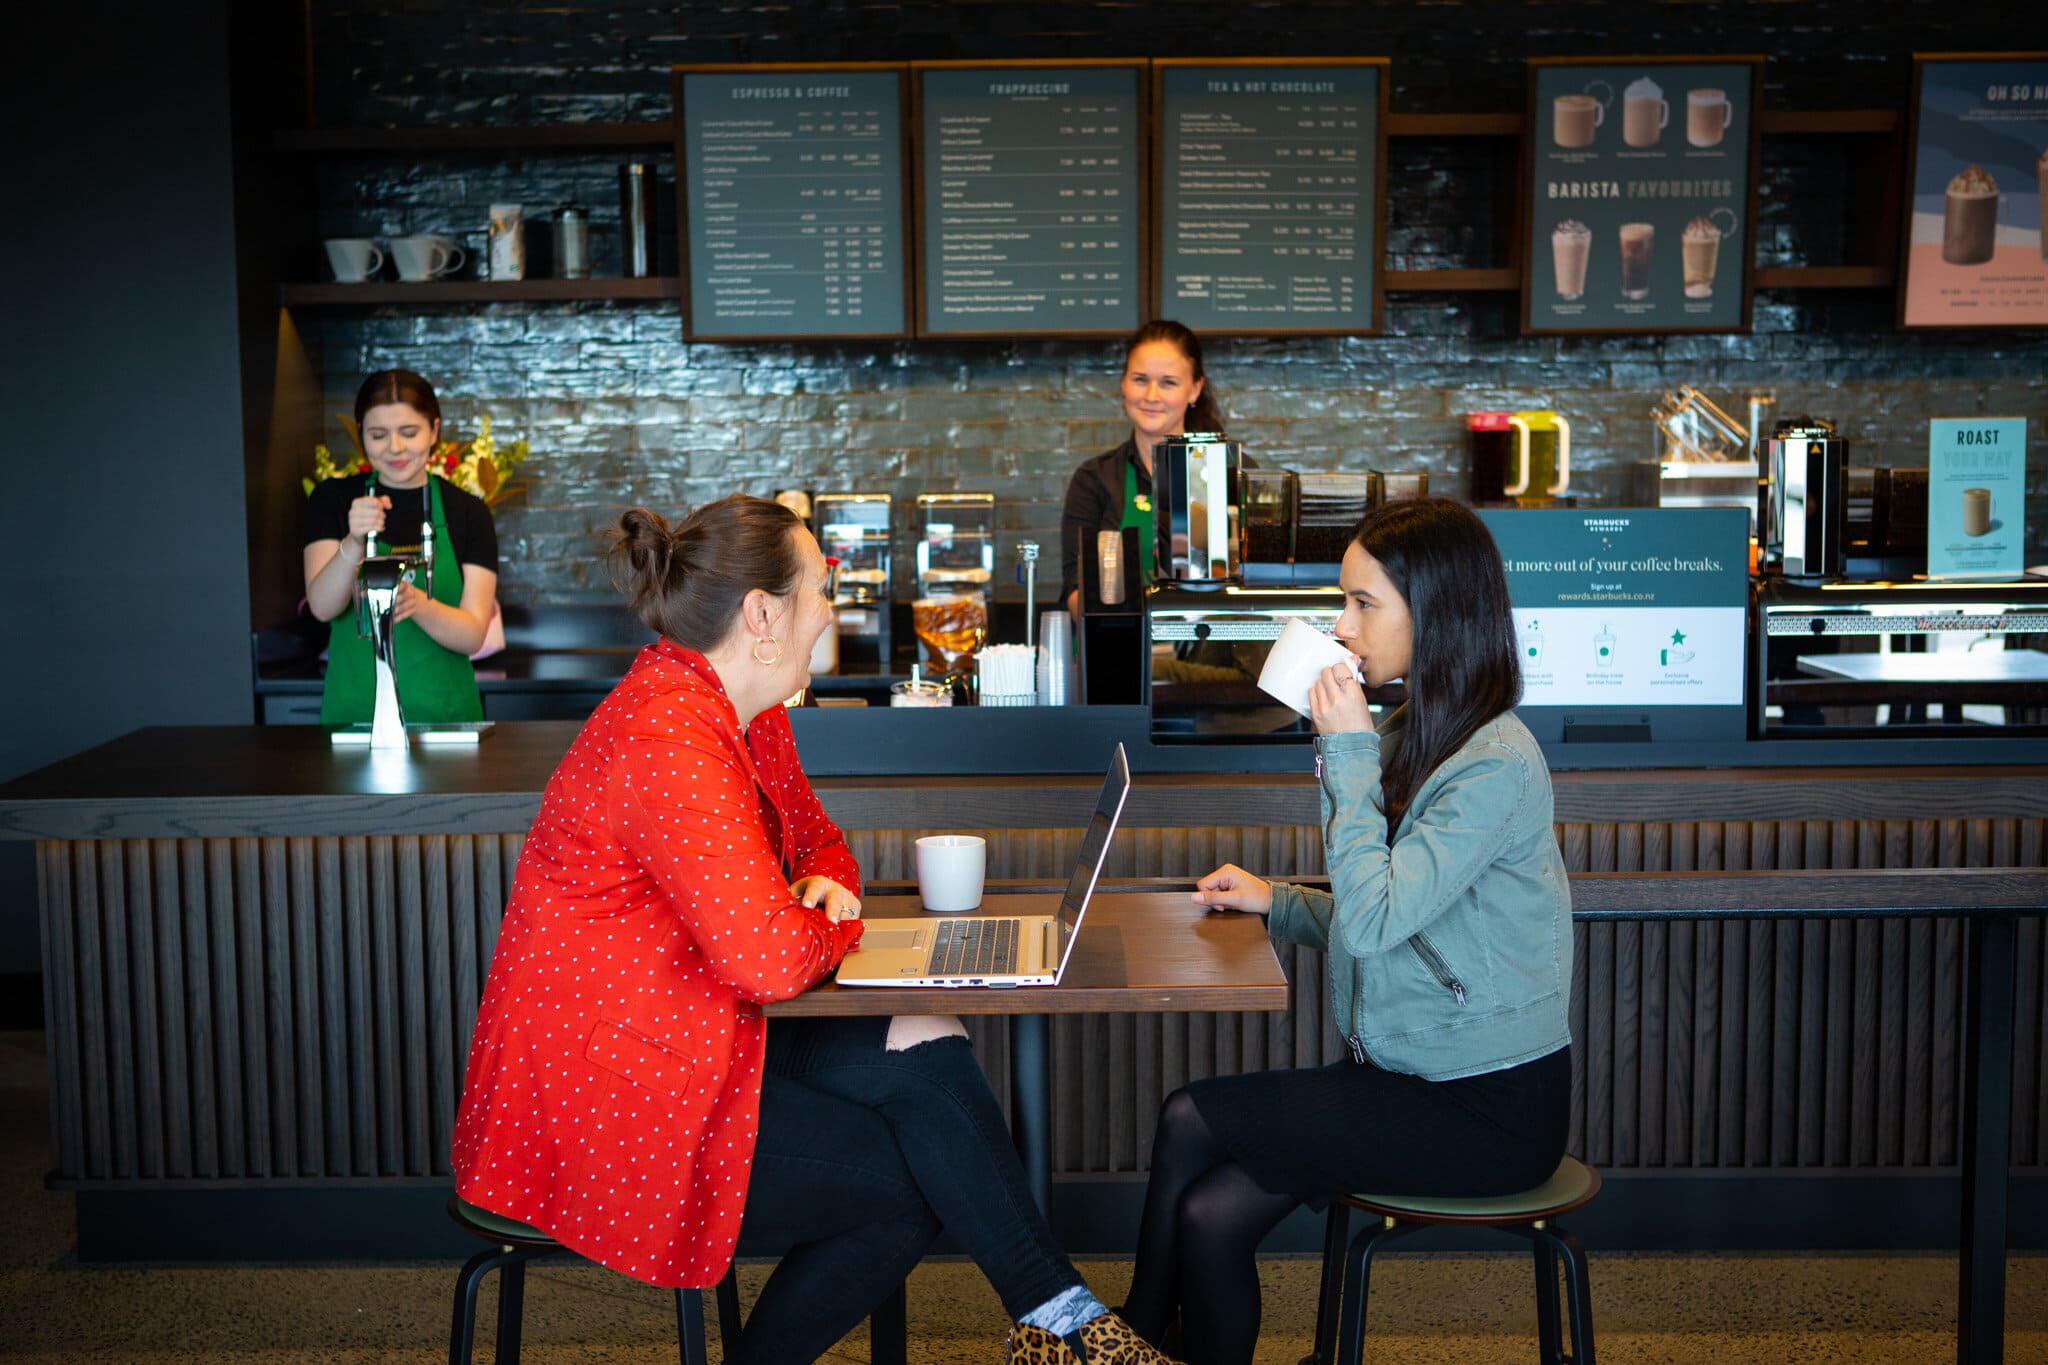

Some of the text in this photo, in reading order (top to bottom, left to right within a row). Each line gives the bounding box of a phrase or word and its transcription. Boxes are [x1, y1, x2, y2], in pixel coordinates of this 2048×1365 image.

[732, 87, 850, 99] ESPRESSO & COFFEE
[989, 84, 1070, 95] FRAPPUCCINO
[1208, 82, 1336, 93] TEA & HOT CHOCOLATE
[1988, 86, 2008, 100] OH
[2011, 86, 2030, 100] SO
[1547, 180, 1732, 199] BARISTA FAVOURITES
[1957, 430, 1999, 445] ROAST
[1516, 561, 1552, 572] more
[1554, 559, 1577, 572] out
[1579, 557, 1595, 572] of
[1596, 560, 1629, 574] your
[1630, 557, 1672, 572] coffee
[1674, 557, 1724, 572] breaks.
[1590, 583, 1605, 591] Sign
[1558, 592, 1655, 601] rewards.starbucks.co.nz
